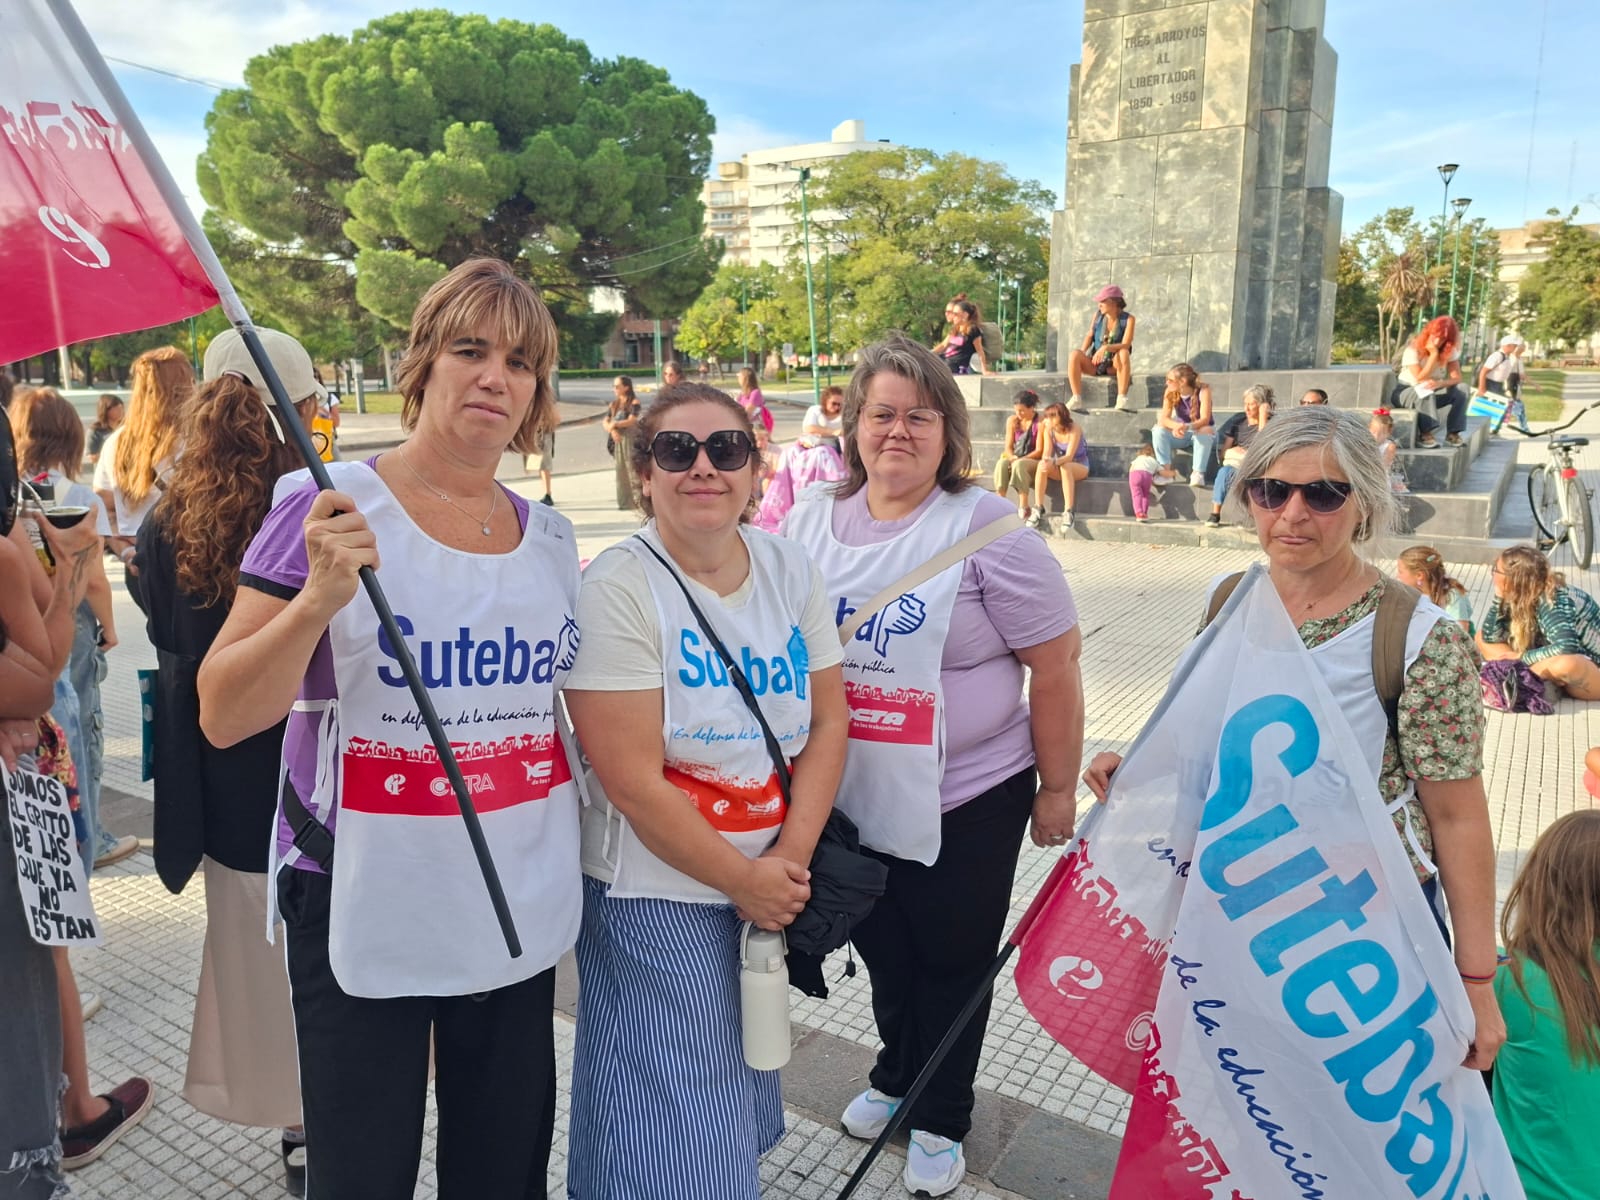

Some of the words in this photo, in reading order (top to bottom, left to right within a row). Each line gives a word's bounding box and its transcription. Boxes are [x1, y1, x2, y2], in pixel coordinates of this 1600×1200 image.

[1124, 35, 1150, 49] TRES
[1154, 25, 1206, 45] ARROYOS
[1156, 52, 1170, 65] AL
[1129, 69, 1196, 89] LIBERTADOR
[1128, 96, 1152, 111] 1850
[1170, 90, 1196, 105] 1950
[377, 614, 556, 689] Suteba
[678, 628, 793, 696] Suba
[862, 660, 896, 675] pública
[382, 712, 397, 723] en
[457, 709, 470, 726] de
[473, 708, 483, 724] la
[487, 706, 540, 721] educación
[673, 728, 689, 739] En
[692, 726, 735, 745] defensa
[8, 790, 26, 822] EL
[25, 801, 71, 840] GRITO
[13, 822, 33, 854] DE
[39, 832, 72, 867] LAS
[18, 854, 46, 886] QUE
[48, 865, 77, 893] YA
[38, 886, 61, 911] NO
[30, 904, 96, 941] ESTAN
[1198, 694, 1455, 1198] Suteba
[1170, 954, 1203, 990] de
[1192, 999, 1227, 1037] la
